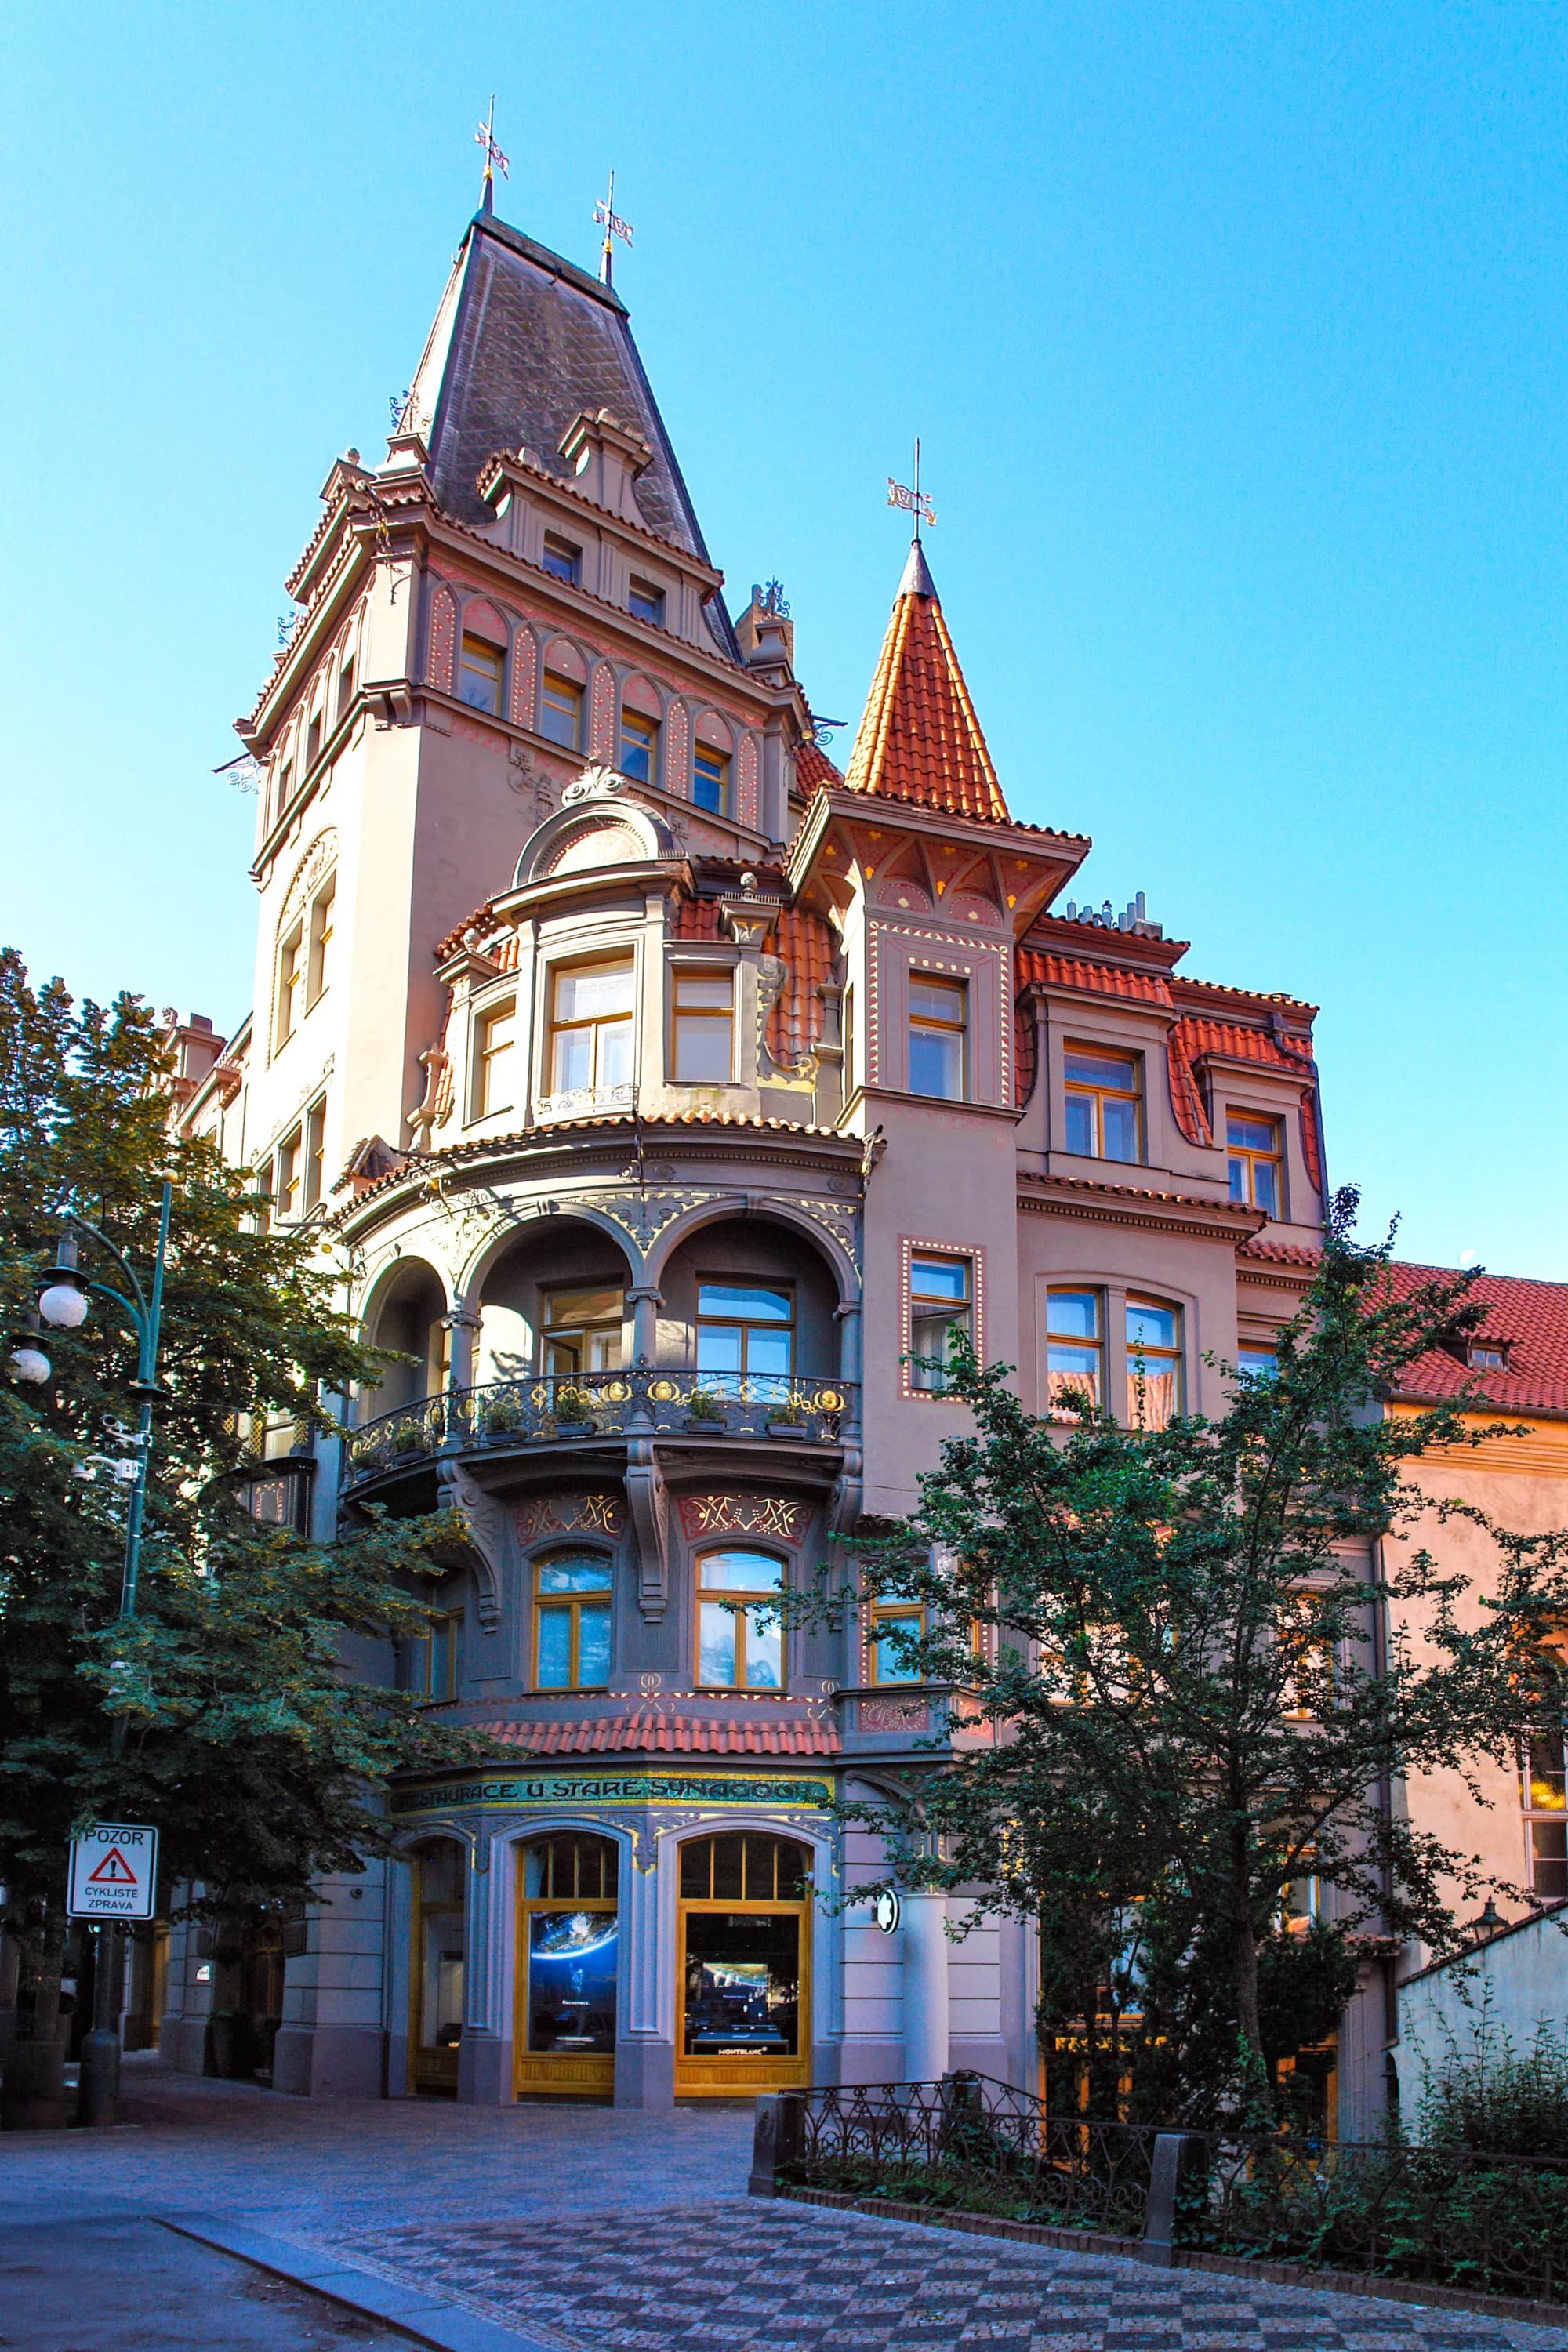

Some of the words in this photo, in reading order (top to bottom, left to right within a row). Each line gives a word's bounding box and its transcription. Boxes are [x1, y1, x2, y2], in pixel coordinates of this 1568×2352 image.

[527, 1784, 543, 1797] U
[551, 1778, 641, 1797] STARÉ
[85, 1829, 143, 1845] POZOR
[88, 1900, 133, 1910] ZPRAVA
